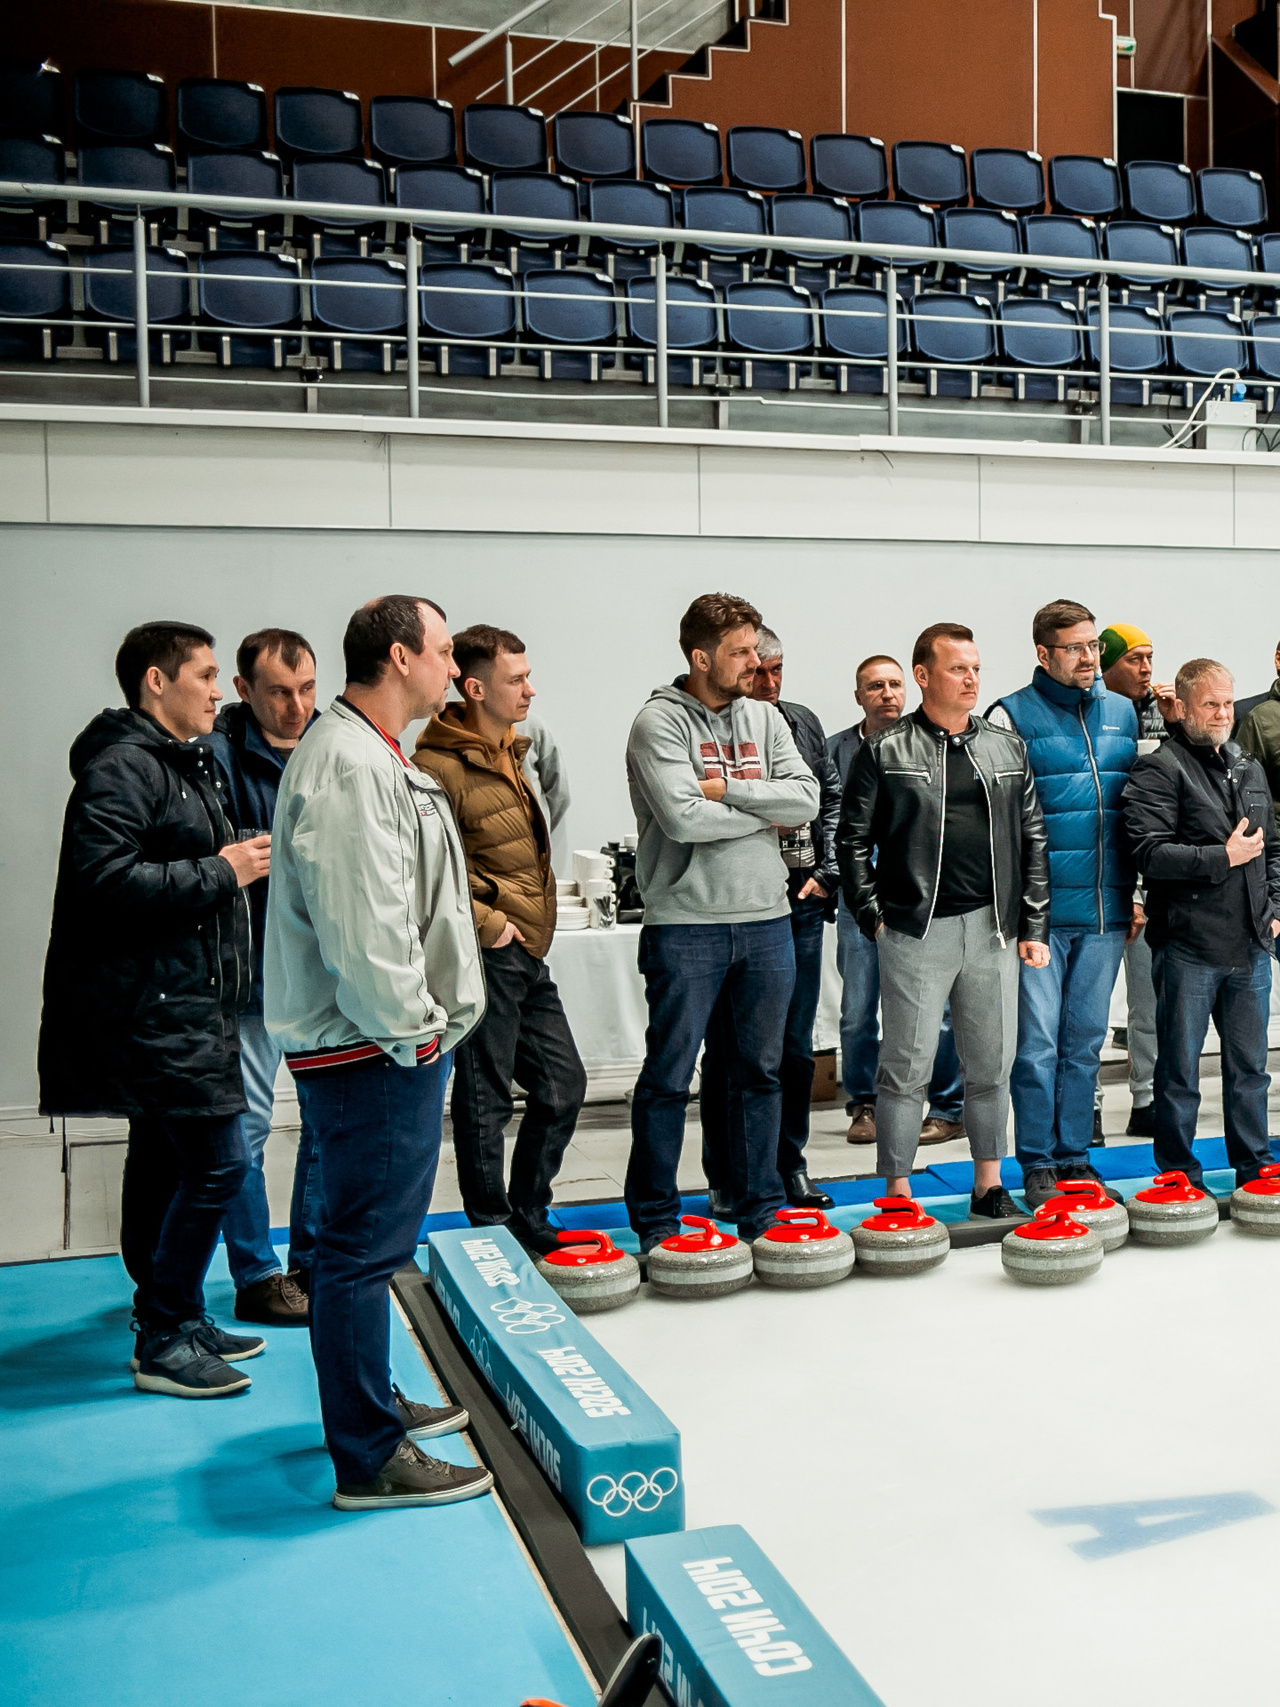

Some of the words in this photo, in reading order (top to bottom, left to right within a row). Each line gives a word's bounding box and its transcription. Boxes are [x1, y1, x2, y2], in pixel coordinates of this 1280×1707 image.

[537, 1346, 596, 1376] 2014
[561, 1376, 631, 1418] SOCHI
[1028, 1490, 1280, 1563] A
[682, 1556, 764, 1610] 2014
